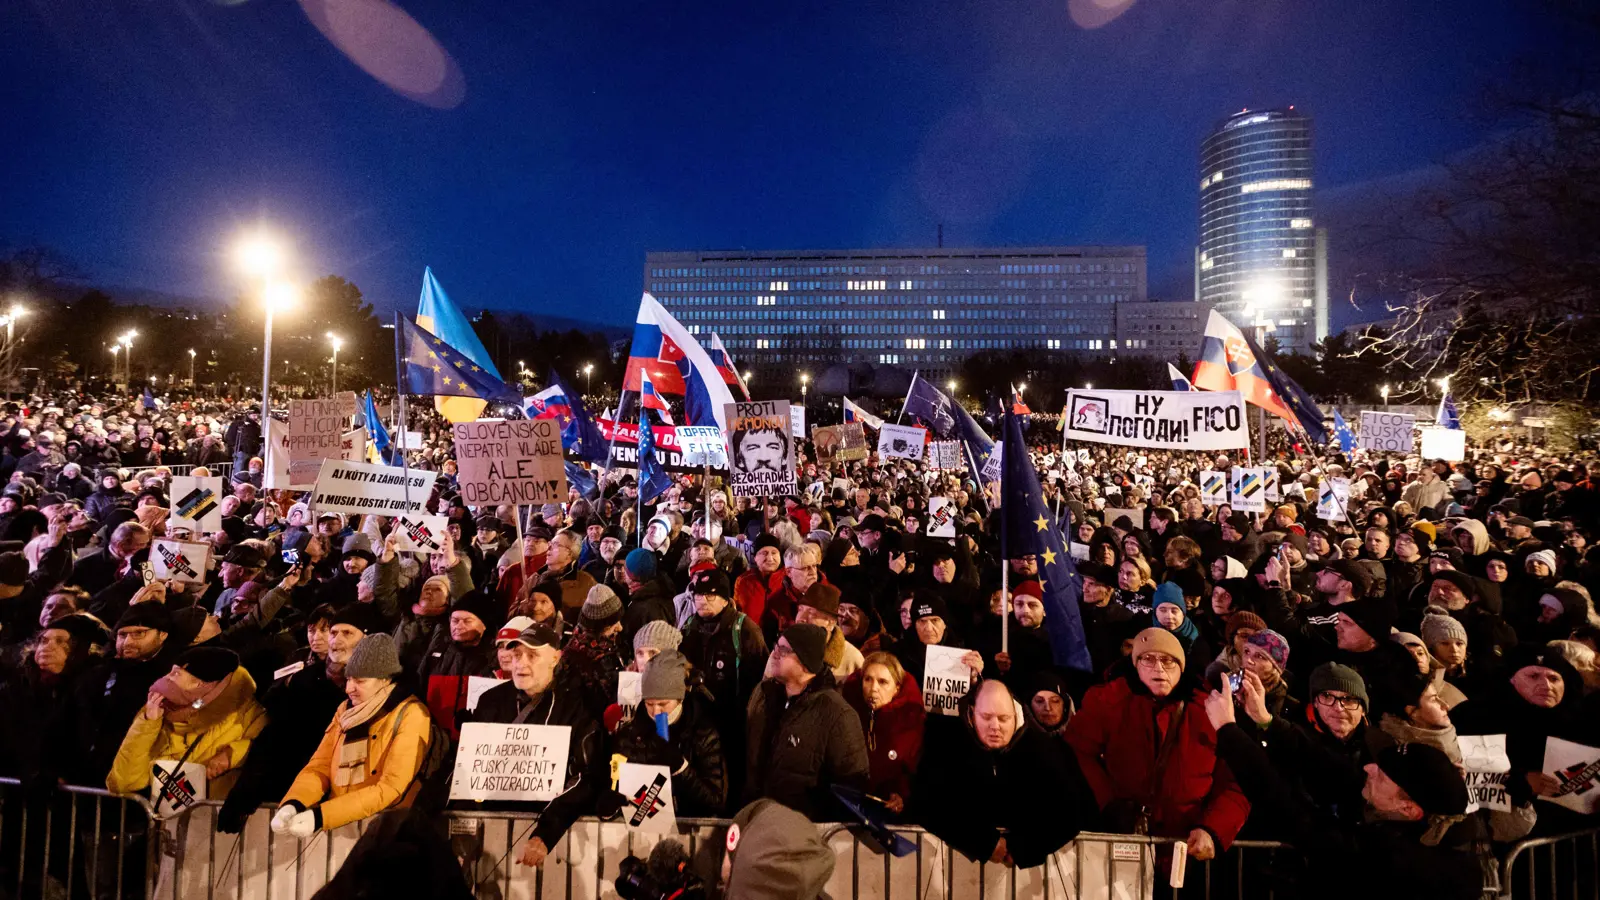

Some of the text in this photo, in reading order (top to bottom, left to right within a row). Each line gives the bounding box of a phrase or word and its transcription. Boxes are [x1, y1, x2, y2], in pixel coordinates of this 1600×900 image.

[736, 402, 776, 418] PROTI
[1136, 394, 1164, 416] НУ
[1192, 404, 1240, 432] FICO
[1109, 414, 1188, 442] ПОГОДИ!
[1360, 425, 1412, 440] RUSKÝ
[460, 440, 509, 458] NEPATRÍ
[1362, 437, 1408, 452] TROL
[332, 469, 343, 480] AJ
[344, 470, 370, 482] KÚTY
[377, 473, 413, 486] ZÁHORE
[413, 477, 426, 487] SÚ
[488, 460, 534, 480] ALE
[316, 494, 324, 503] A
[325, 495, 355, 506] MUSIA
[356, 498, 390, 508] ZOSTAŤ
[926, 676, 967, 694] MY SME
[505, 728, 530, 740] FICO
[472, 758, 510, 773] RUSKÝ
[634, 783, 660, 821] VLASTIZRADA
[1468, 785, 1506, 805] URÓPA
